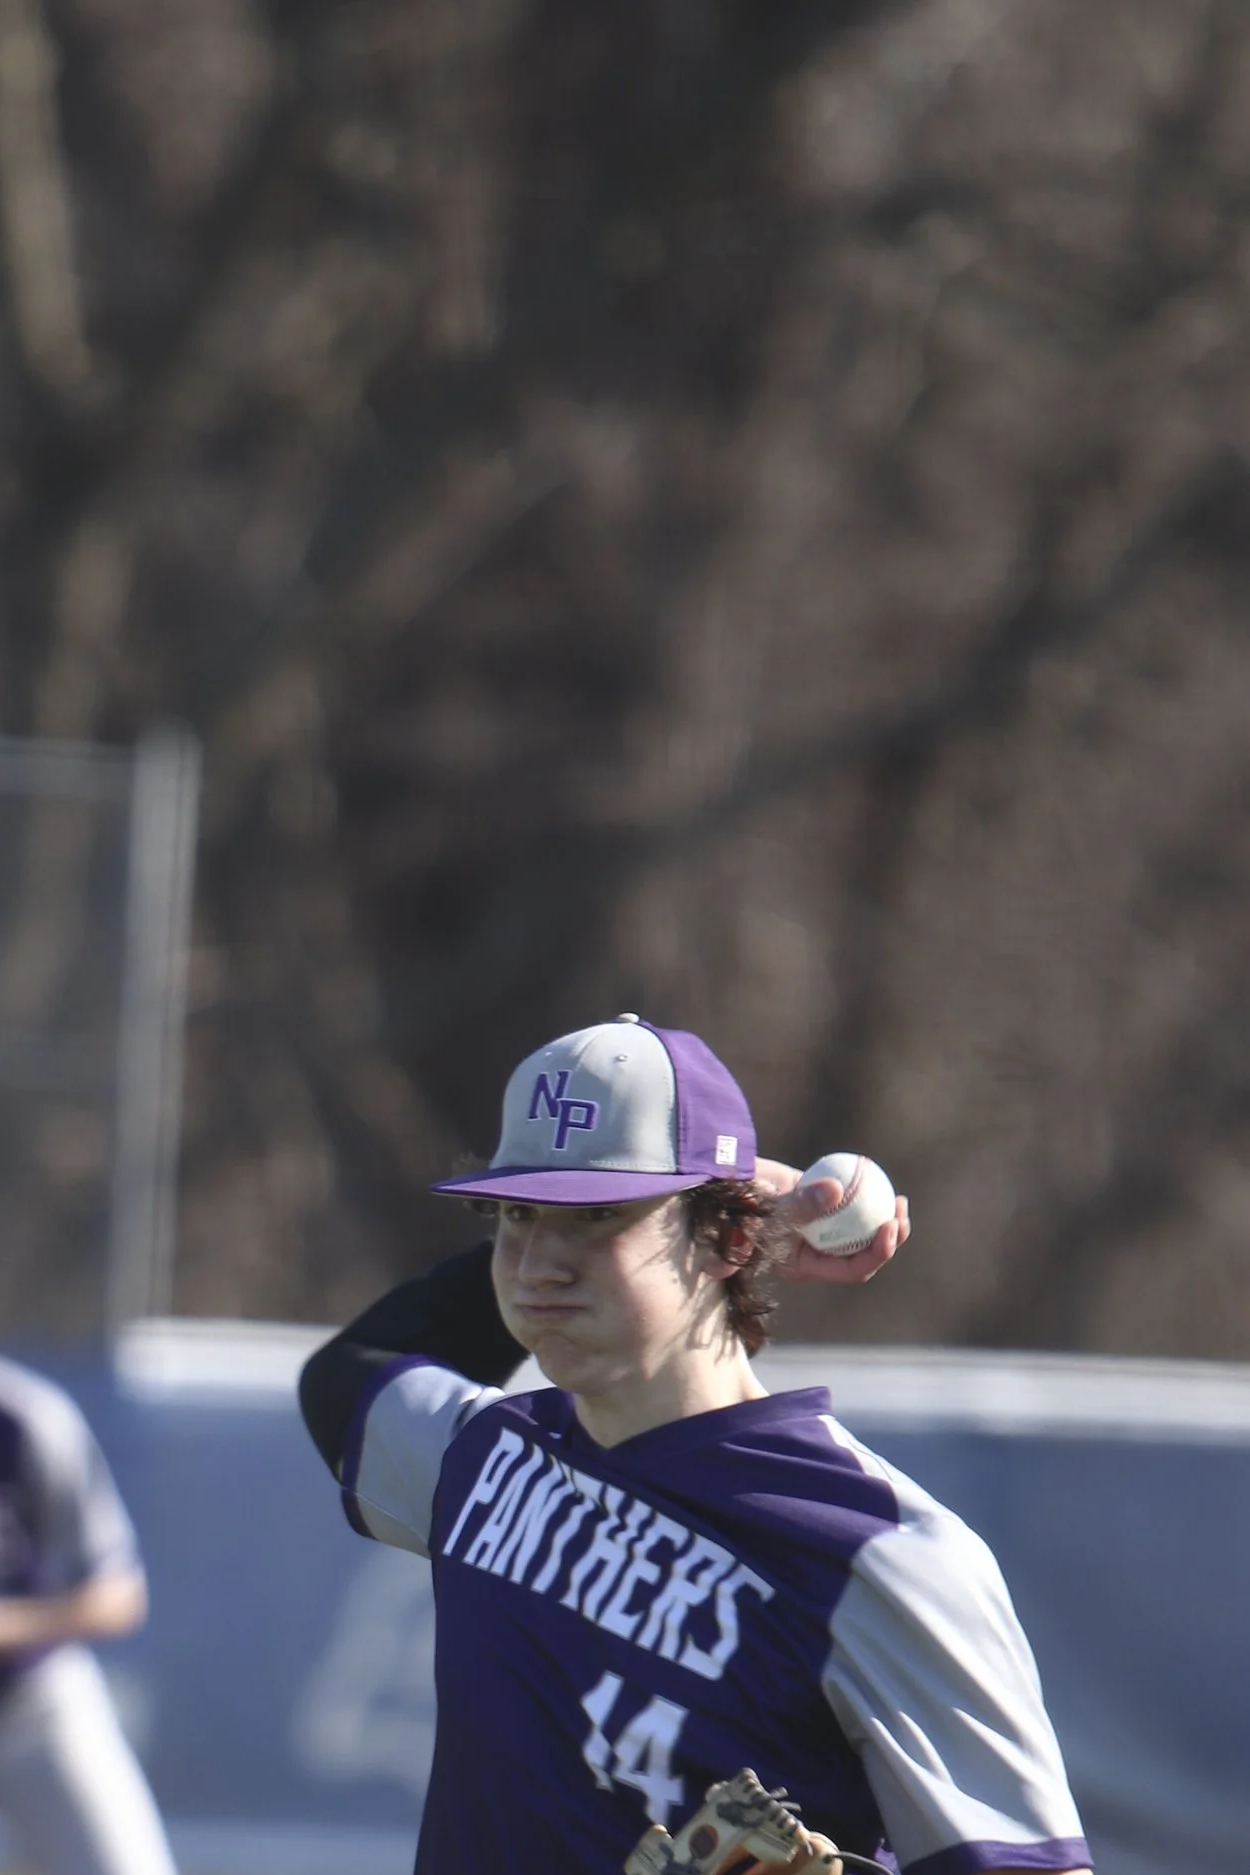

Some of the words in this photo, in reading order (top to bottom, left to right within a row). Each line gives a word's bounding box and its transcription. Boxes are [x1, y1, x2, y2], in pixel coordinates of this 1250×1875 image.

[528, 1068, 598, 1151] NP
[441, 1425, 778, 1682] PANTHERS
[580, 1670, 689, 1830] 14
